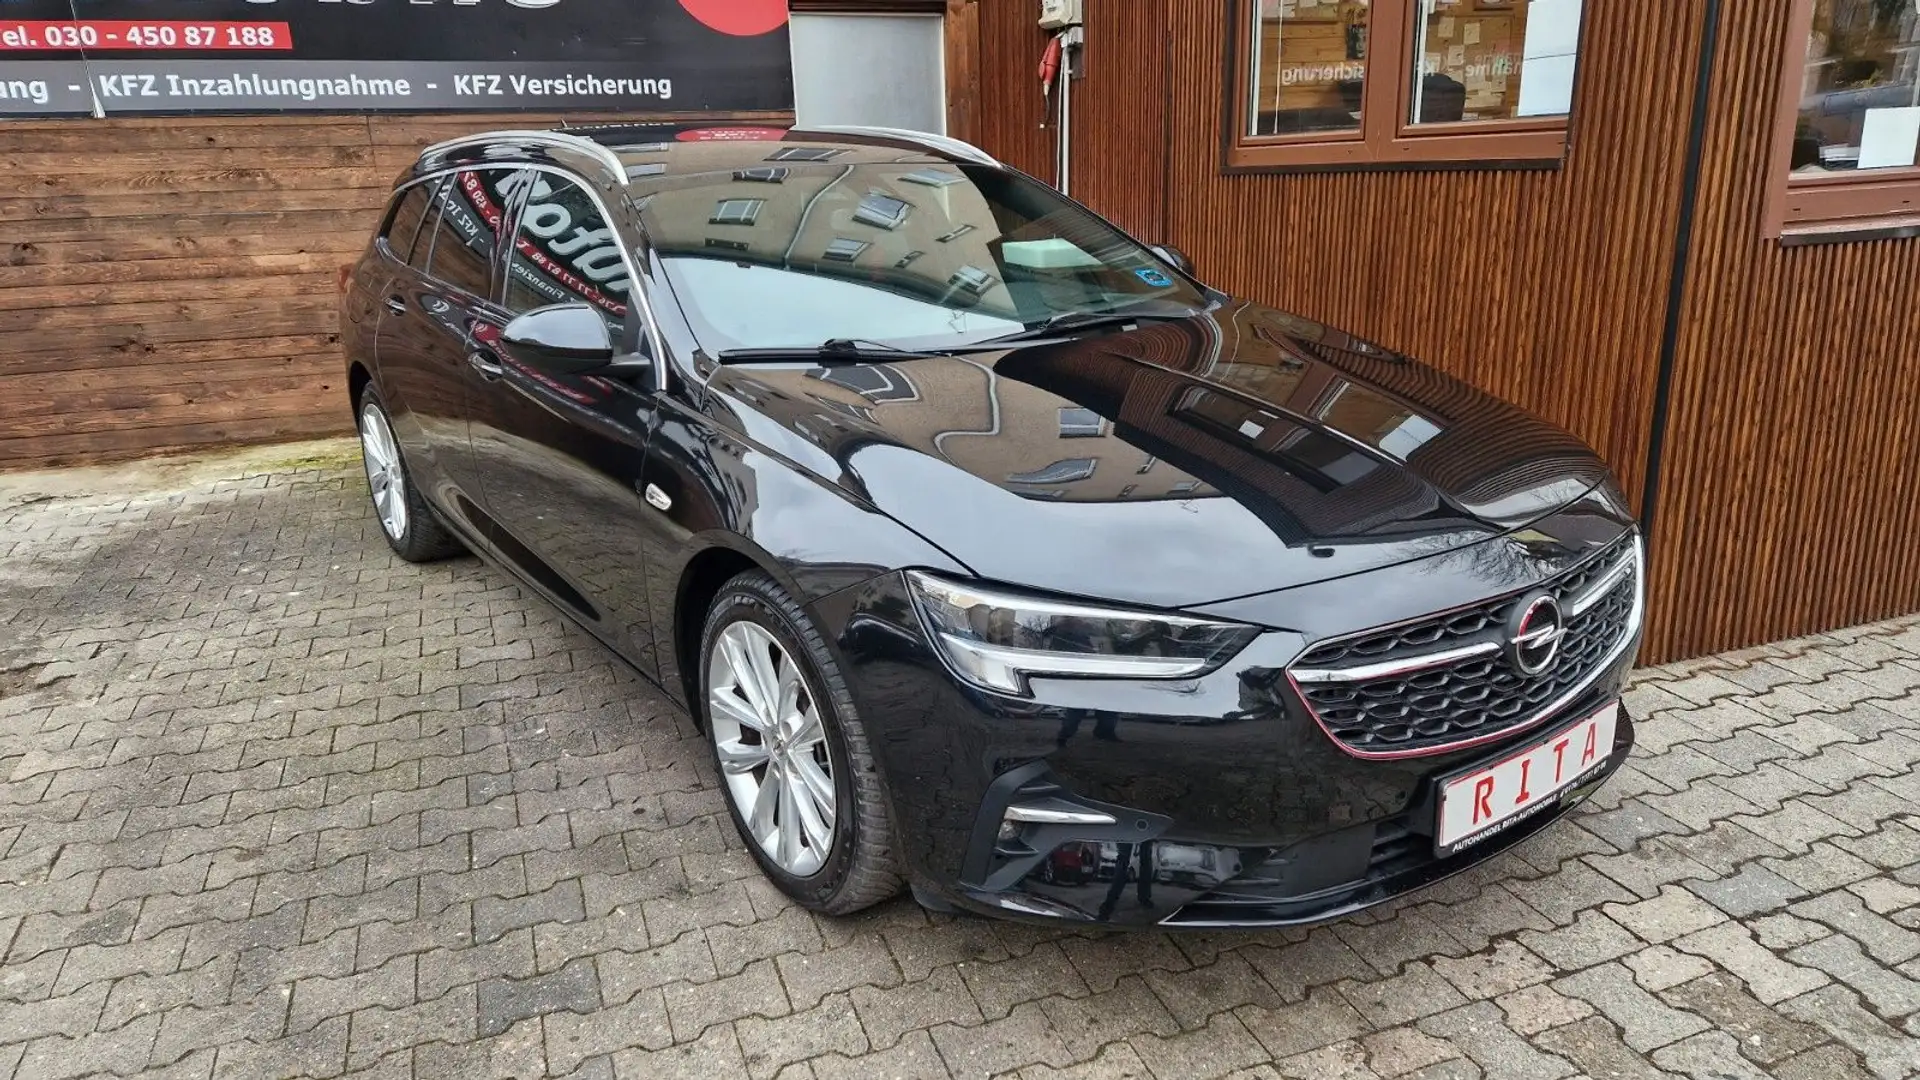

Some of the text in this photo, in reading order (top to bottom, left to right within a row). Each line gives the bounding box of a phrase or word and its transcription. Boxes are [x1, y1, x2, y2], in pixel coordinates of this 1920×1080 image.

[0, 25, 37, 47] el.
[45, 26, 97, 46] 030
[126, 26, 176, 46] 450
[184, 26, 216, 46] 87
[226, 26, 274, 46] 188
[100, 75, 159, 97] KFZ
[166, 73, 411, 100] Inzahlungnahme
[454, 74, 502, 96] KFZ
[509, 74, 672, 99] Versicherung
